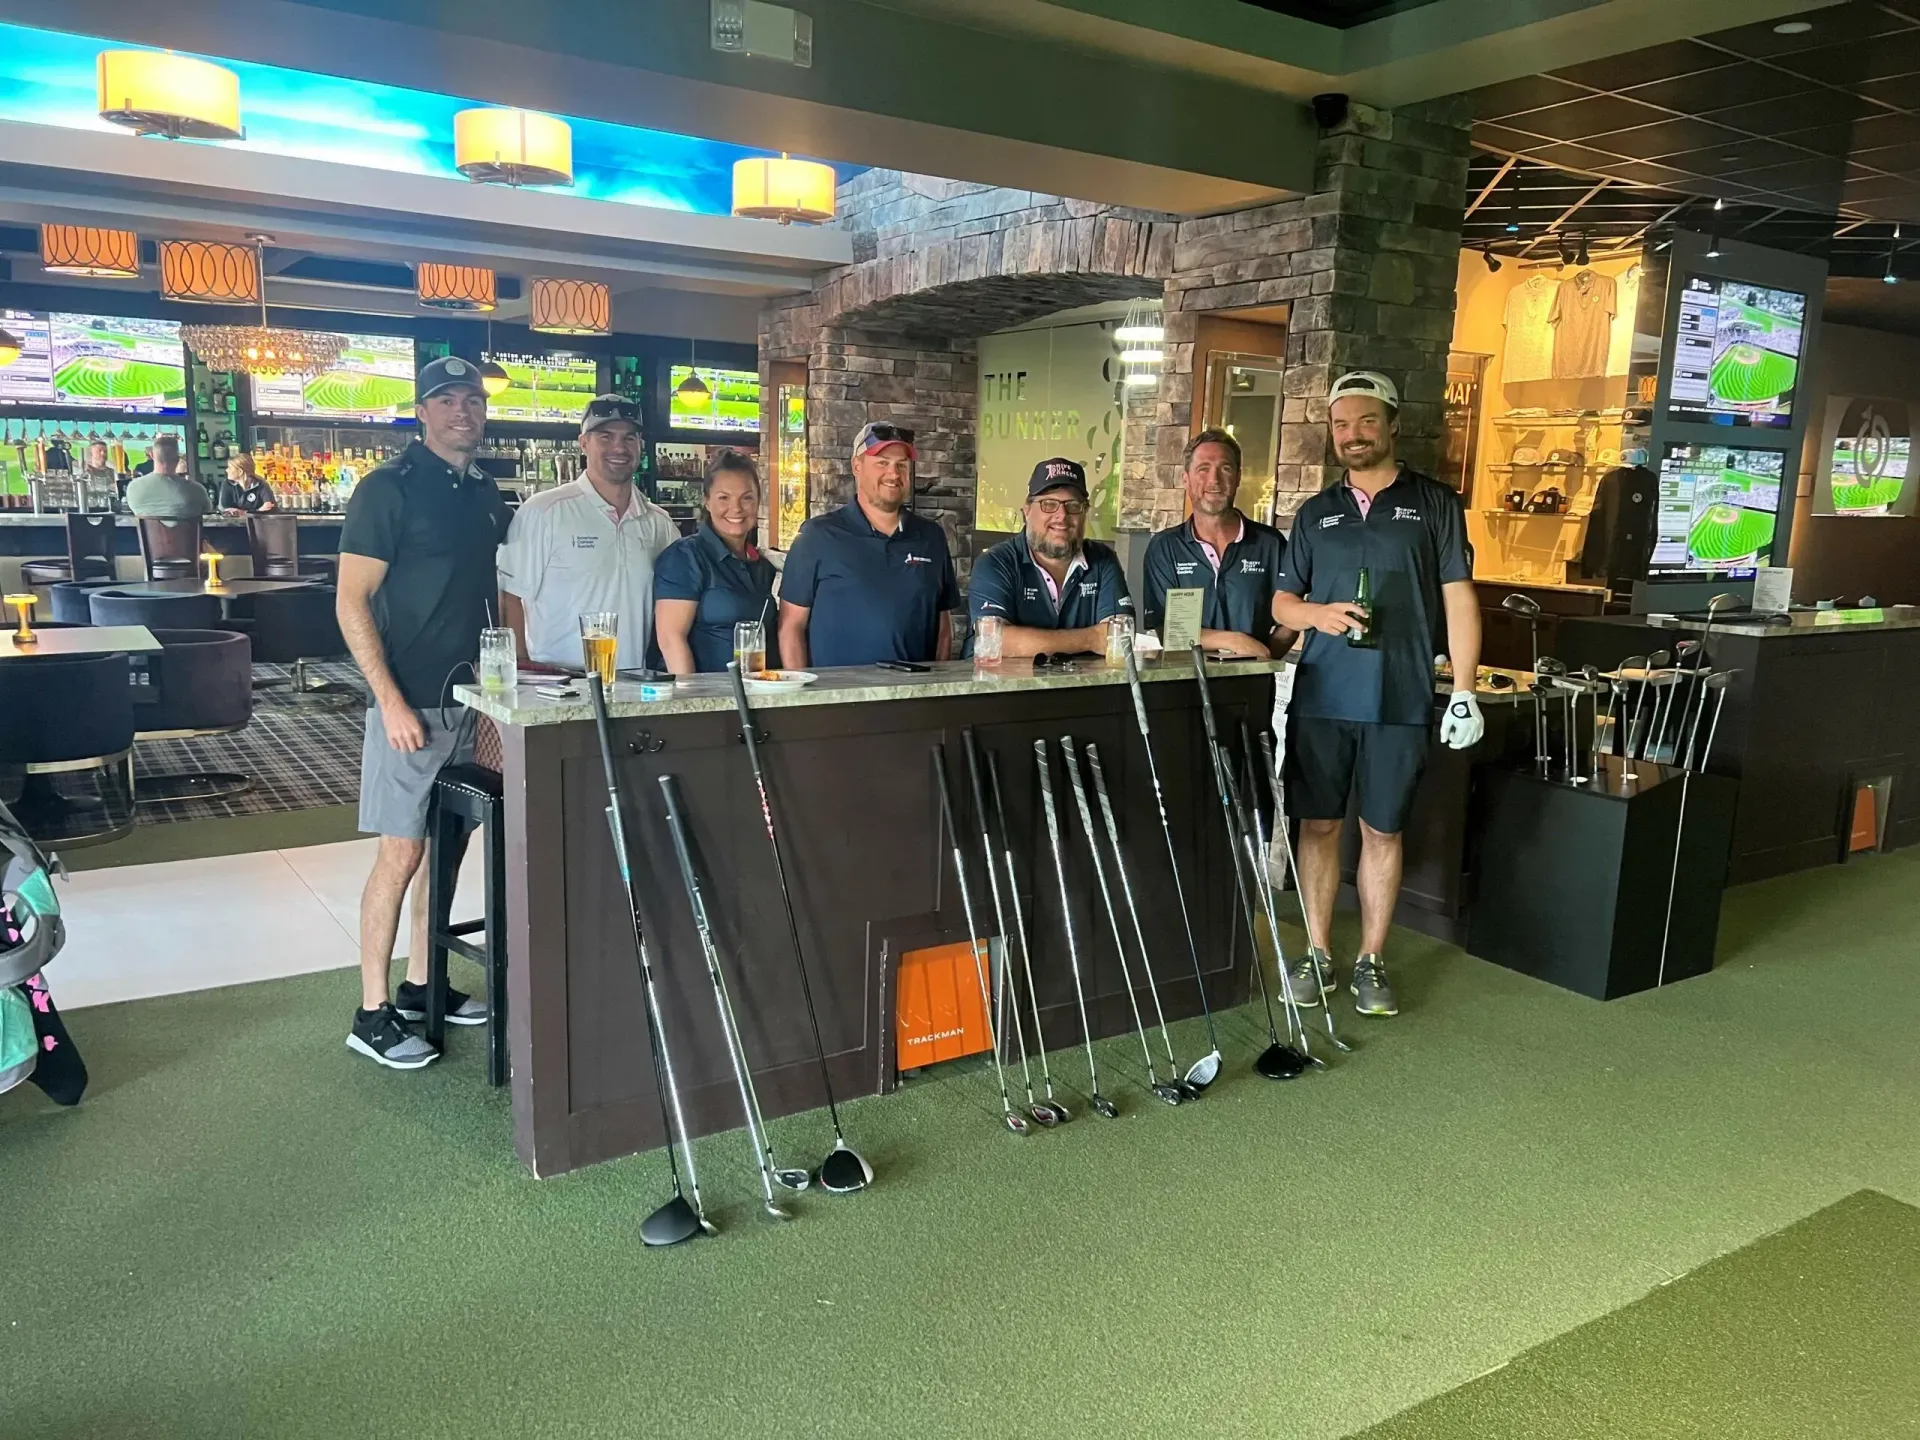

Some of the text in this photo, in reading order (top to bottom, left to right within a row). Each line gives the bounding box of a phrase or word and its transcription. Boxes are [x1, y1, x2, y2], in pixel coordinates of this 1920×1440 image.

[984, 371, 1026, 401] THE
[983, 410, 1079, 440] BUNKER
[906, 1027, 964, 1046] TRACKMAN
